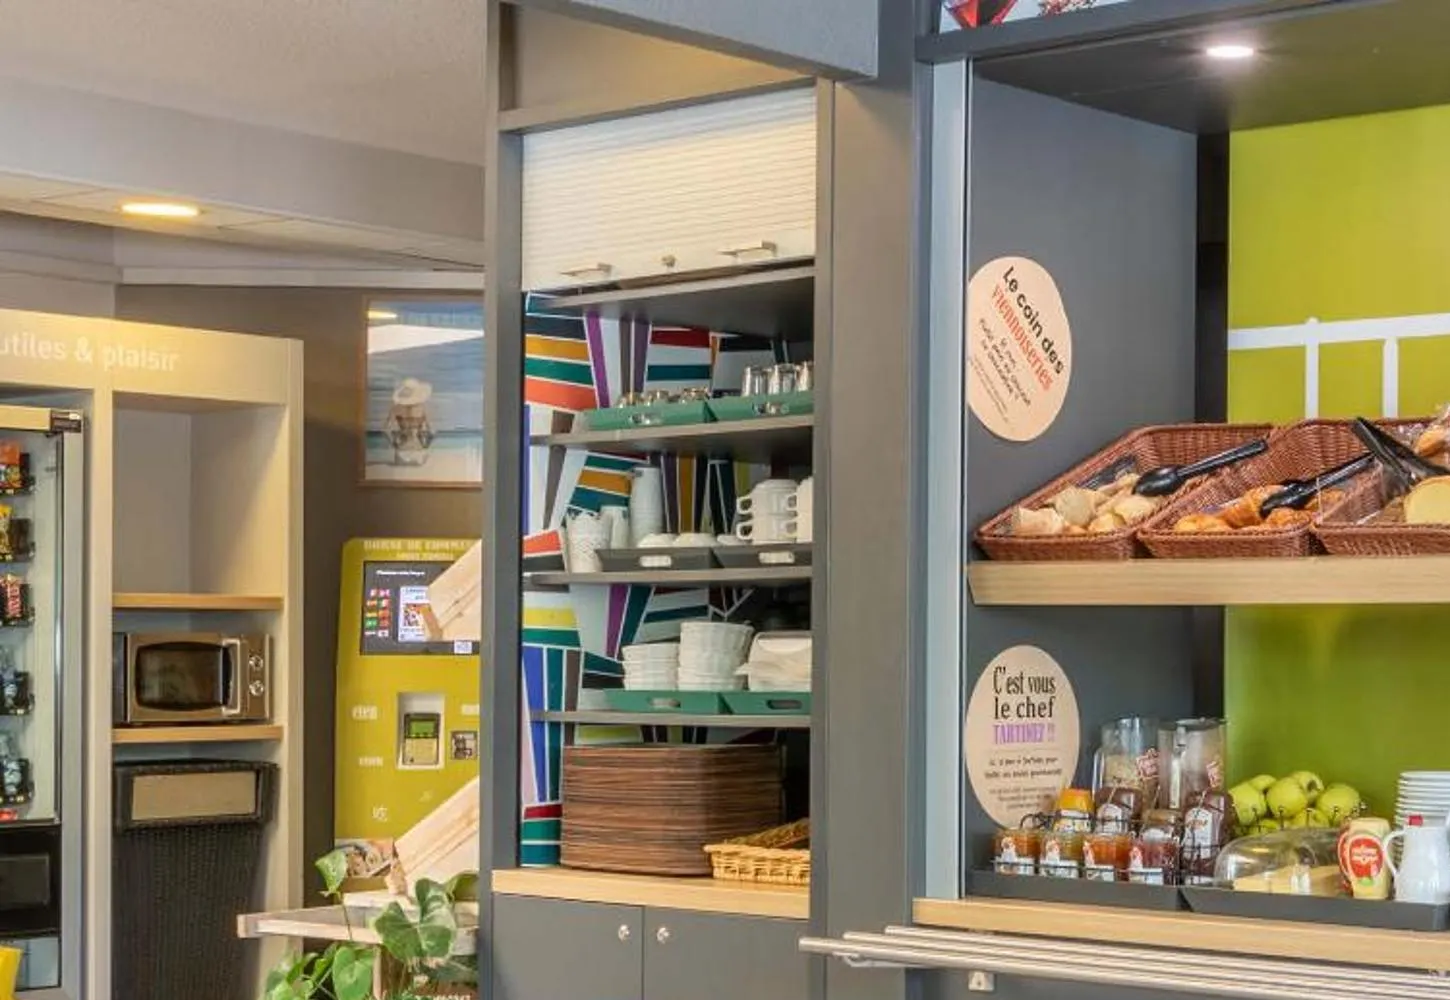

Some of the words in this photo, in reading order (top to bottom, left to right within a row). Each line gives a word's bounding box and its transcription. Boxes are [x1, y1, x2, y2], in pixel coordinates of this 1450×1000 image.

[1002, 266, 1018, 293] Le
[1016, 292, 1044, 337] coin
[1041, 337, 1065, 375] des
[102, 342, 180, 372] plaisir
[993, 665, 1025, 695] C'est
[1028, 675, 1057, 695] vous
[994, 697, 1011, 720] le
[1016, 695, 1057, 719] chef
